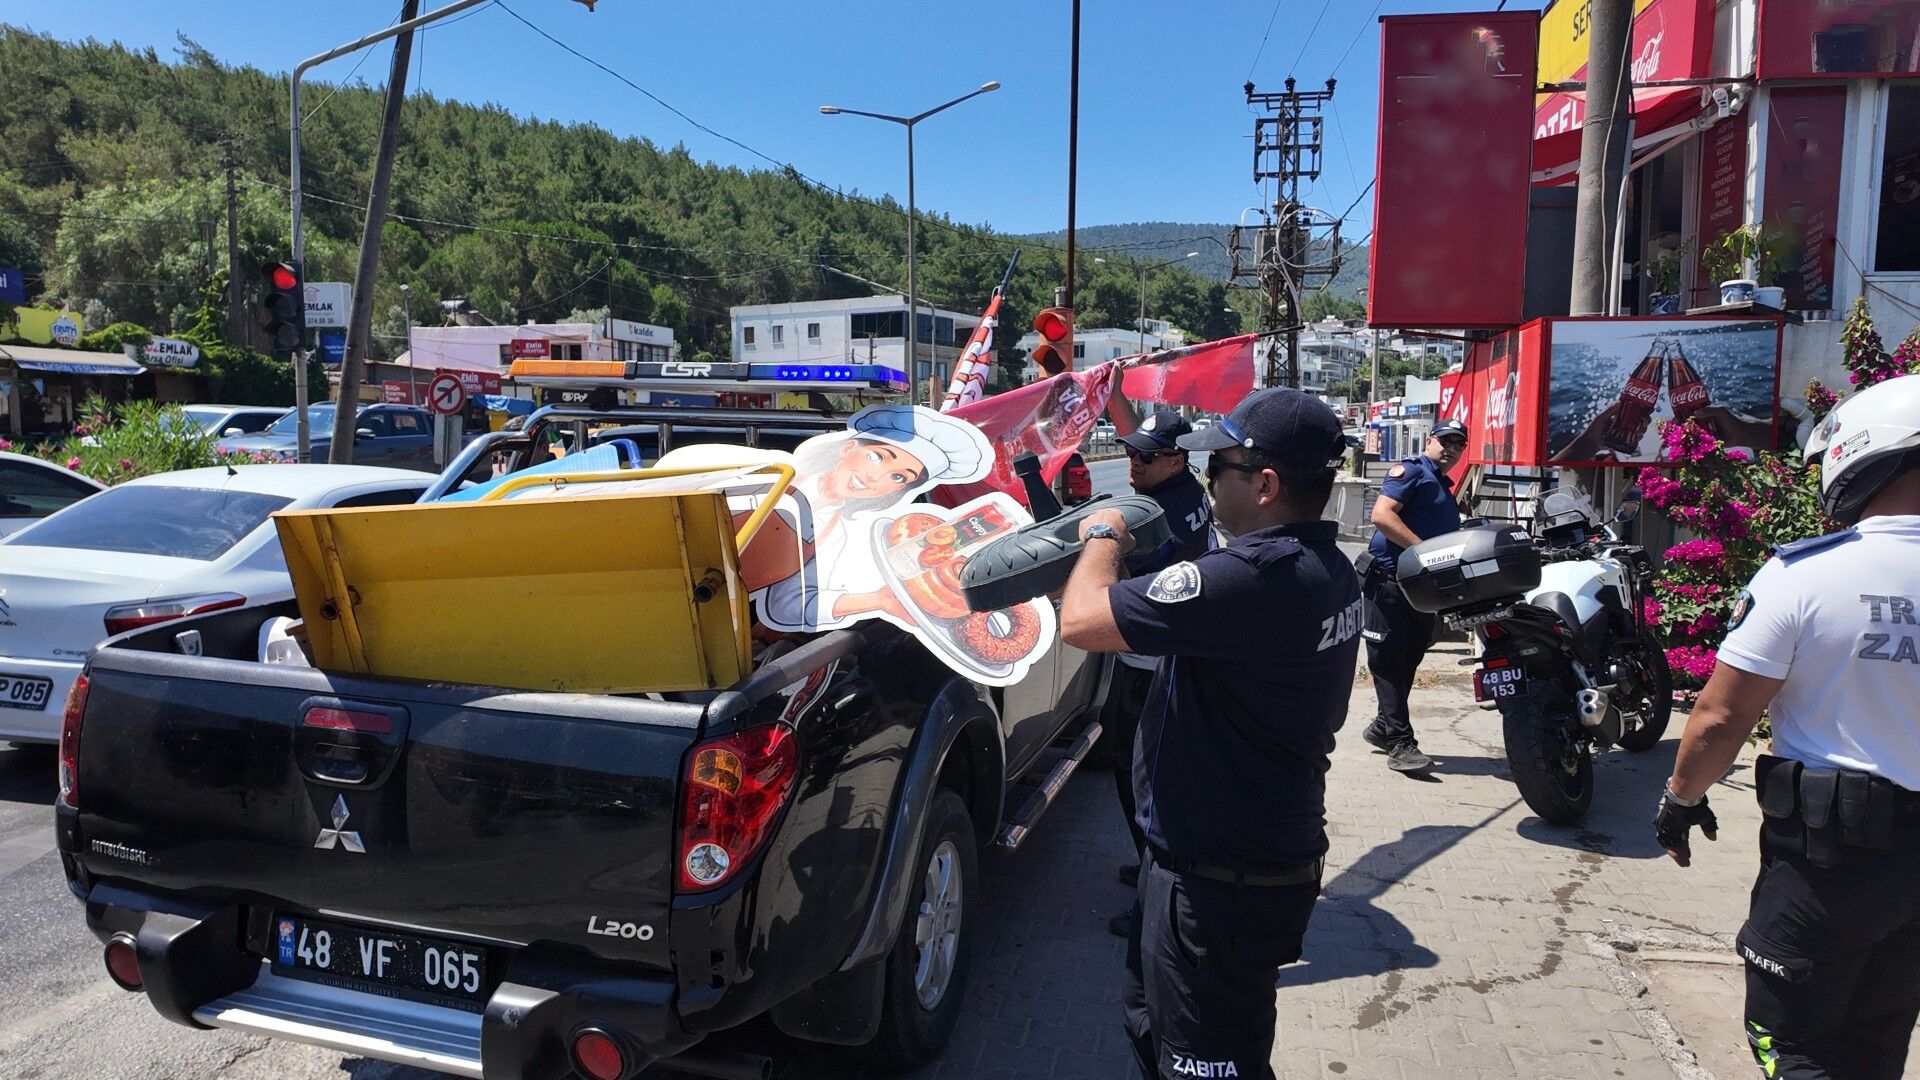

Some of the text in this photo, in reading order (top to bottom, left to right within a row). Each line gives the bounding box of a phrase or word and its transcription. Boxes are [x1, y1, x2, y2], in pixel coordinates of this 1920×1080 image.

[160, 343, 192, 355] EMLAK
[461, 372, 479, 383] EMİR
[661, 363, 712, 378] CSR
[1623, 382, 1657, 404] Coca-Cola
[1671, 385, 1708, 405] Coca-Cola
[969, 516, 986, 535] Cappy
[1427, 553, 1456, 565] TRAFİK
[1860, 594, 1920, 625] TR
[1859, 633, 1920, 664] ZA
[1483, 668, 1522, 685] 48 BU
[11, 681, 46, 701] 085
[1492, 684, 1516, 698] 153
[587, 915, 654, 941] L200
[280, 928, 479, 993] TR 48 VF 065
[1744, 946, 1785, 977] TRAFİK
[1172, 1054, 1238, 1078] ZABITA
